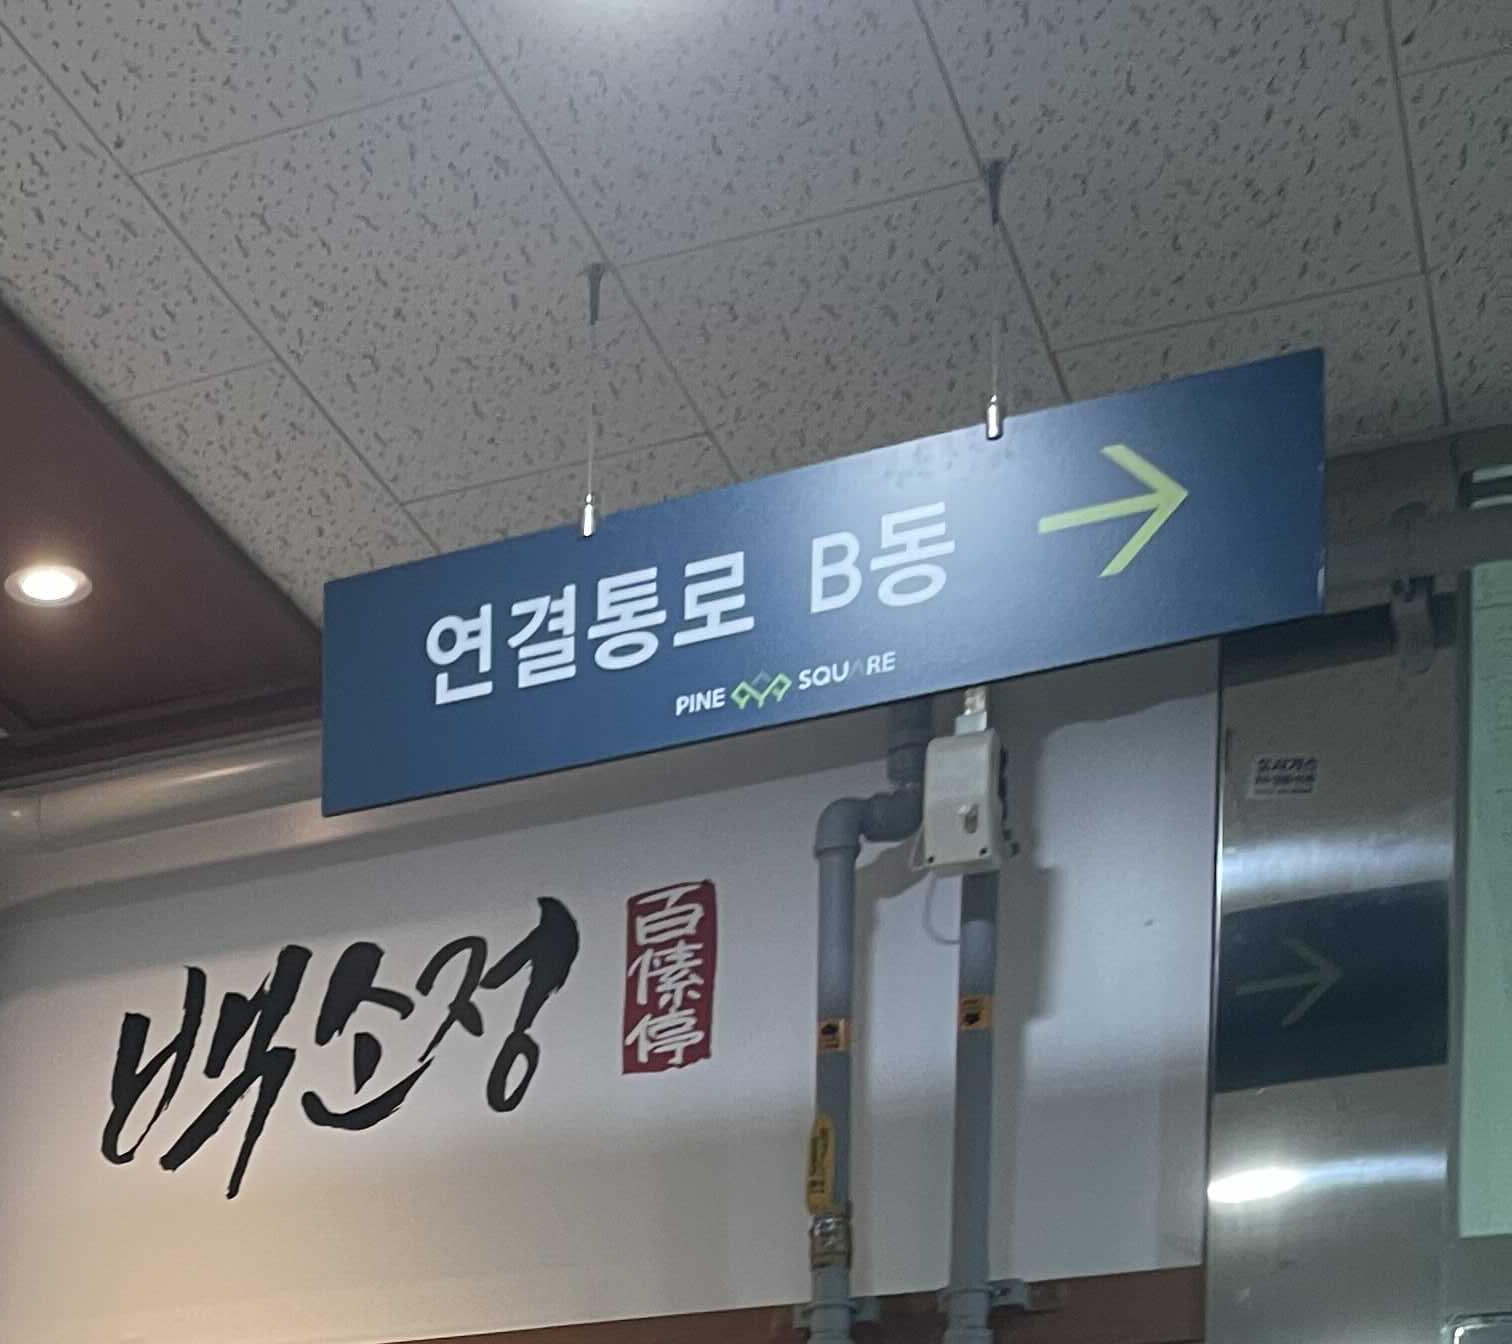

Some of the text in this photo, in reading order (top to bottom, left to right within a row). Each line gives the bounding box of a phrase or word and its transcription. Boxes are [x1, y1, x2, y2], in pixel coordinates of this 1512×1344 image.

[425, 500, 956, 704] 연결통로 B동
[675, 687, 726, 716] PINE
[100, 896, 581, 1200] 백소정
